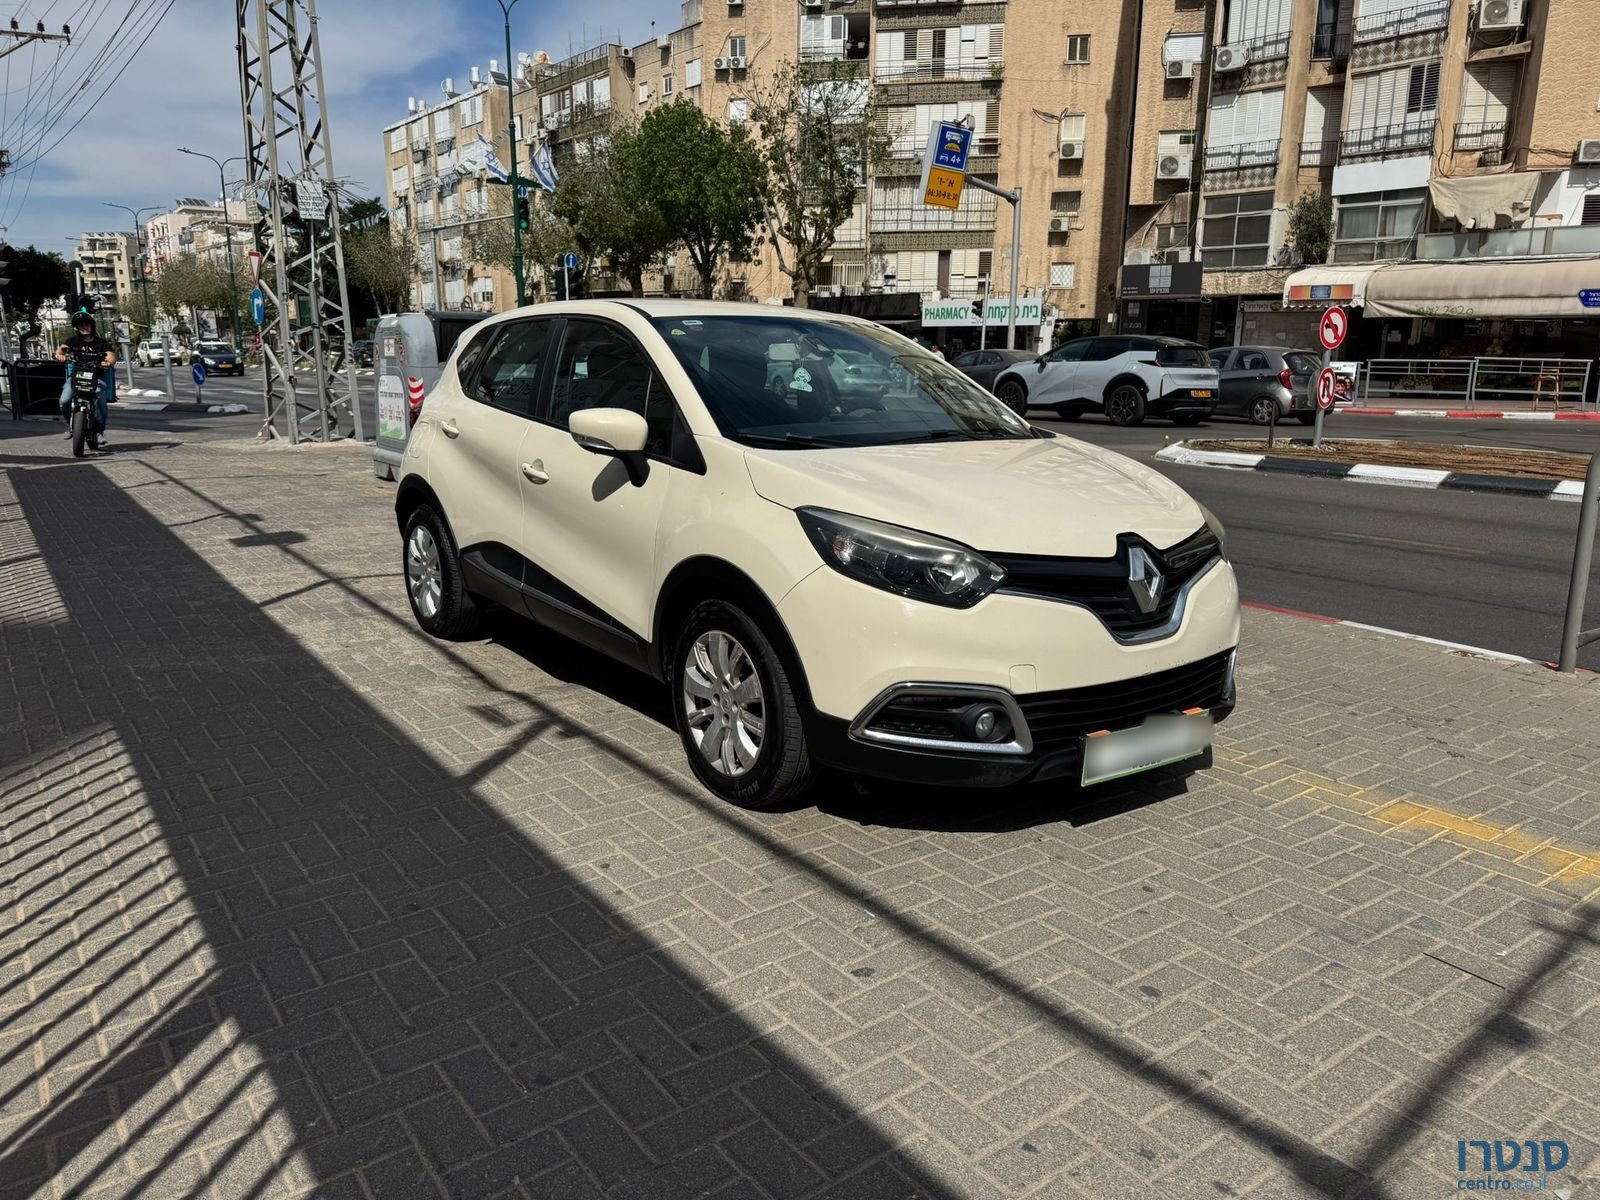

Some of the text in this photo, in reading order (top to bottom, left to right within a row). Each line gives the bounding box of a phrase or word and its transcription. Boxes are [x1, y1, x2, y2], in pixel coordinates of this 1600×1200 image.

[950, 154, 961, 164] 4+
[924, 307, 970, 320] PHARMACY
[987, 305, 1039, 322] בית קחת
